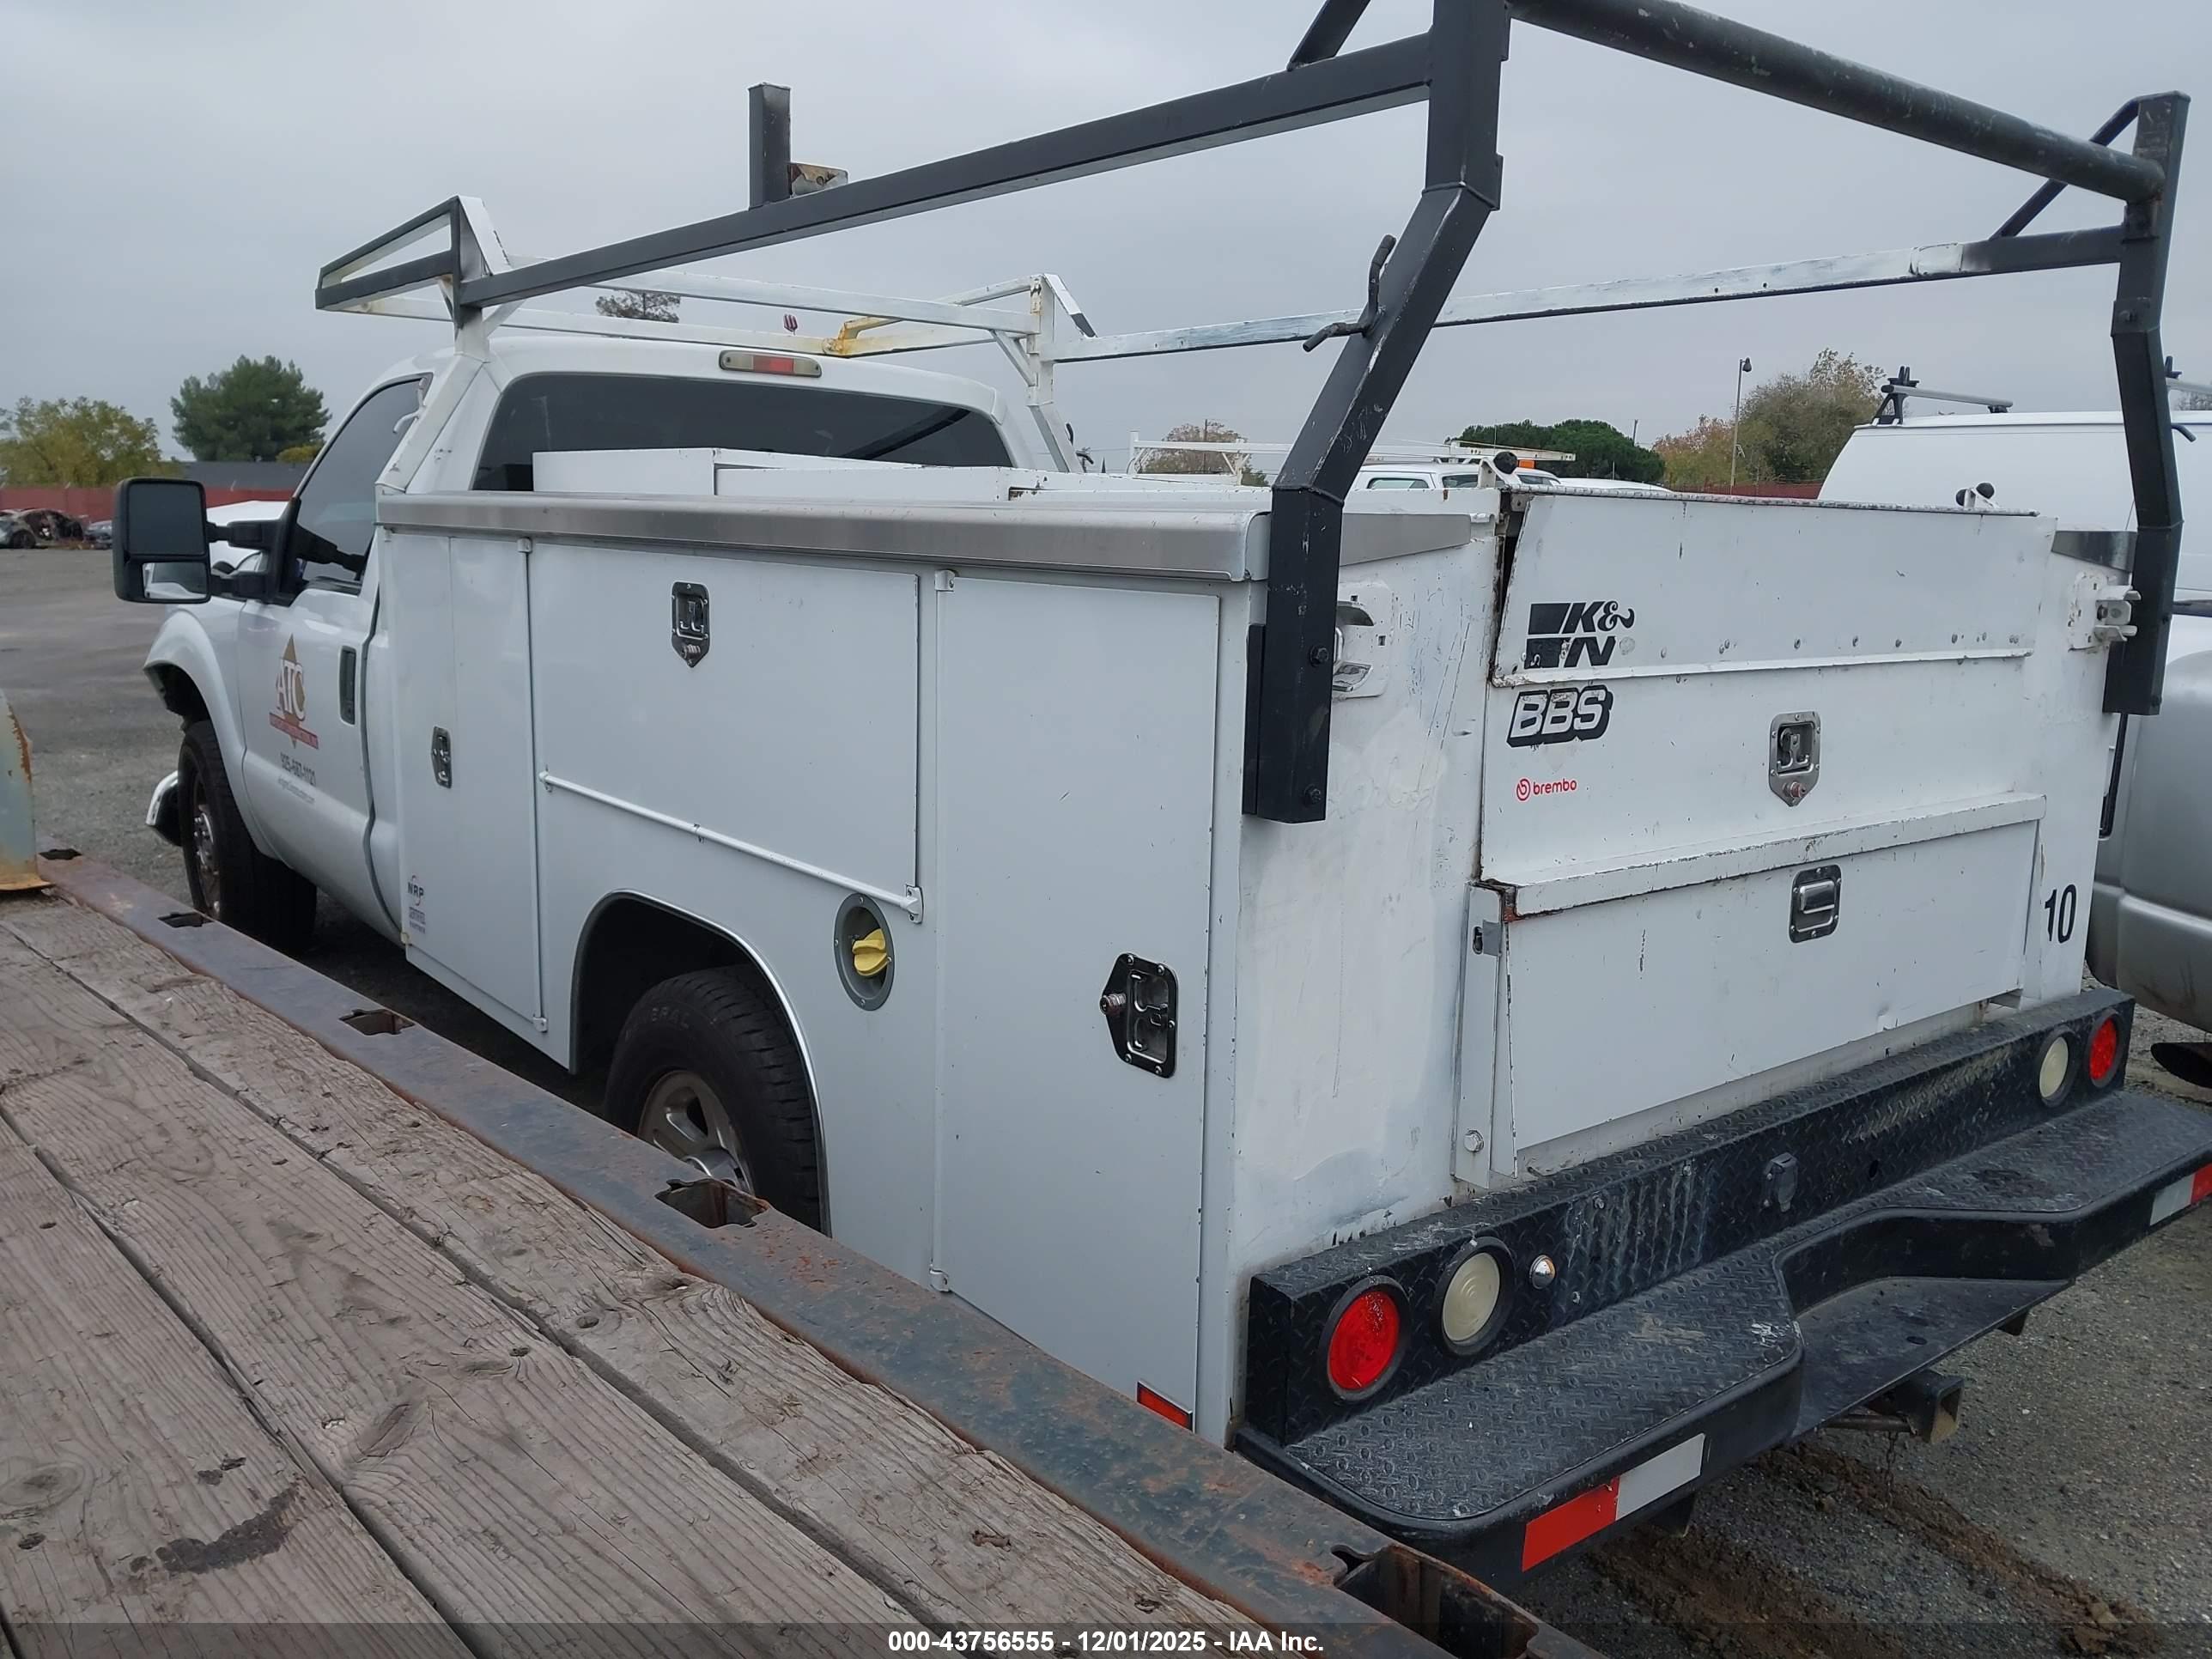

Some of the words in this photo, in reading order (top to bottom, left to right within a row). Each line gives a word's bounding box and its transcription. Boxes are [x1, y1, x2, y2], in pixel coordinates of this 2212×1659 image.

[270, 658, 306, 721] ATC
[1507, 684, 1613, 747] BBS
[1533, 778, 1577, 795] brembo
[2045, 884, 2077, 944] 10
